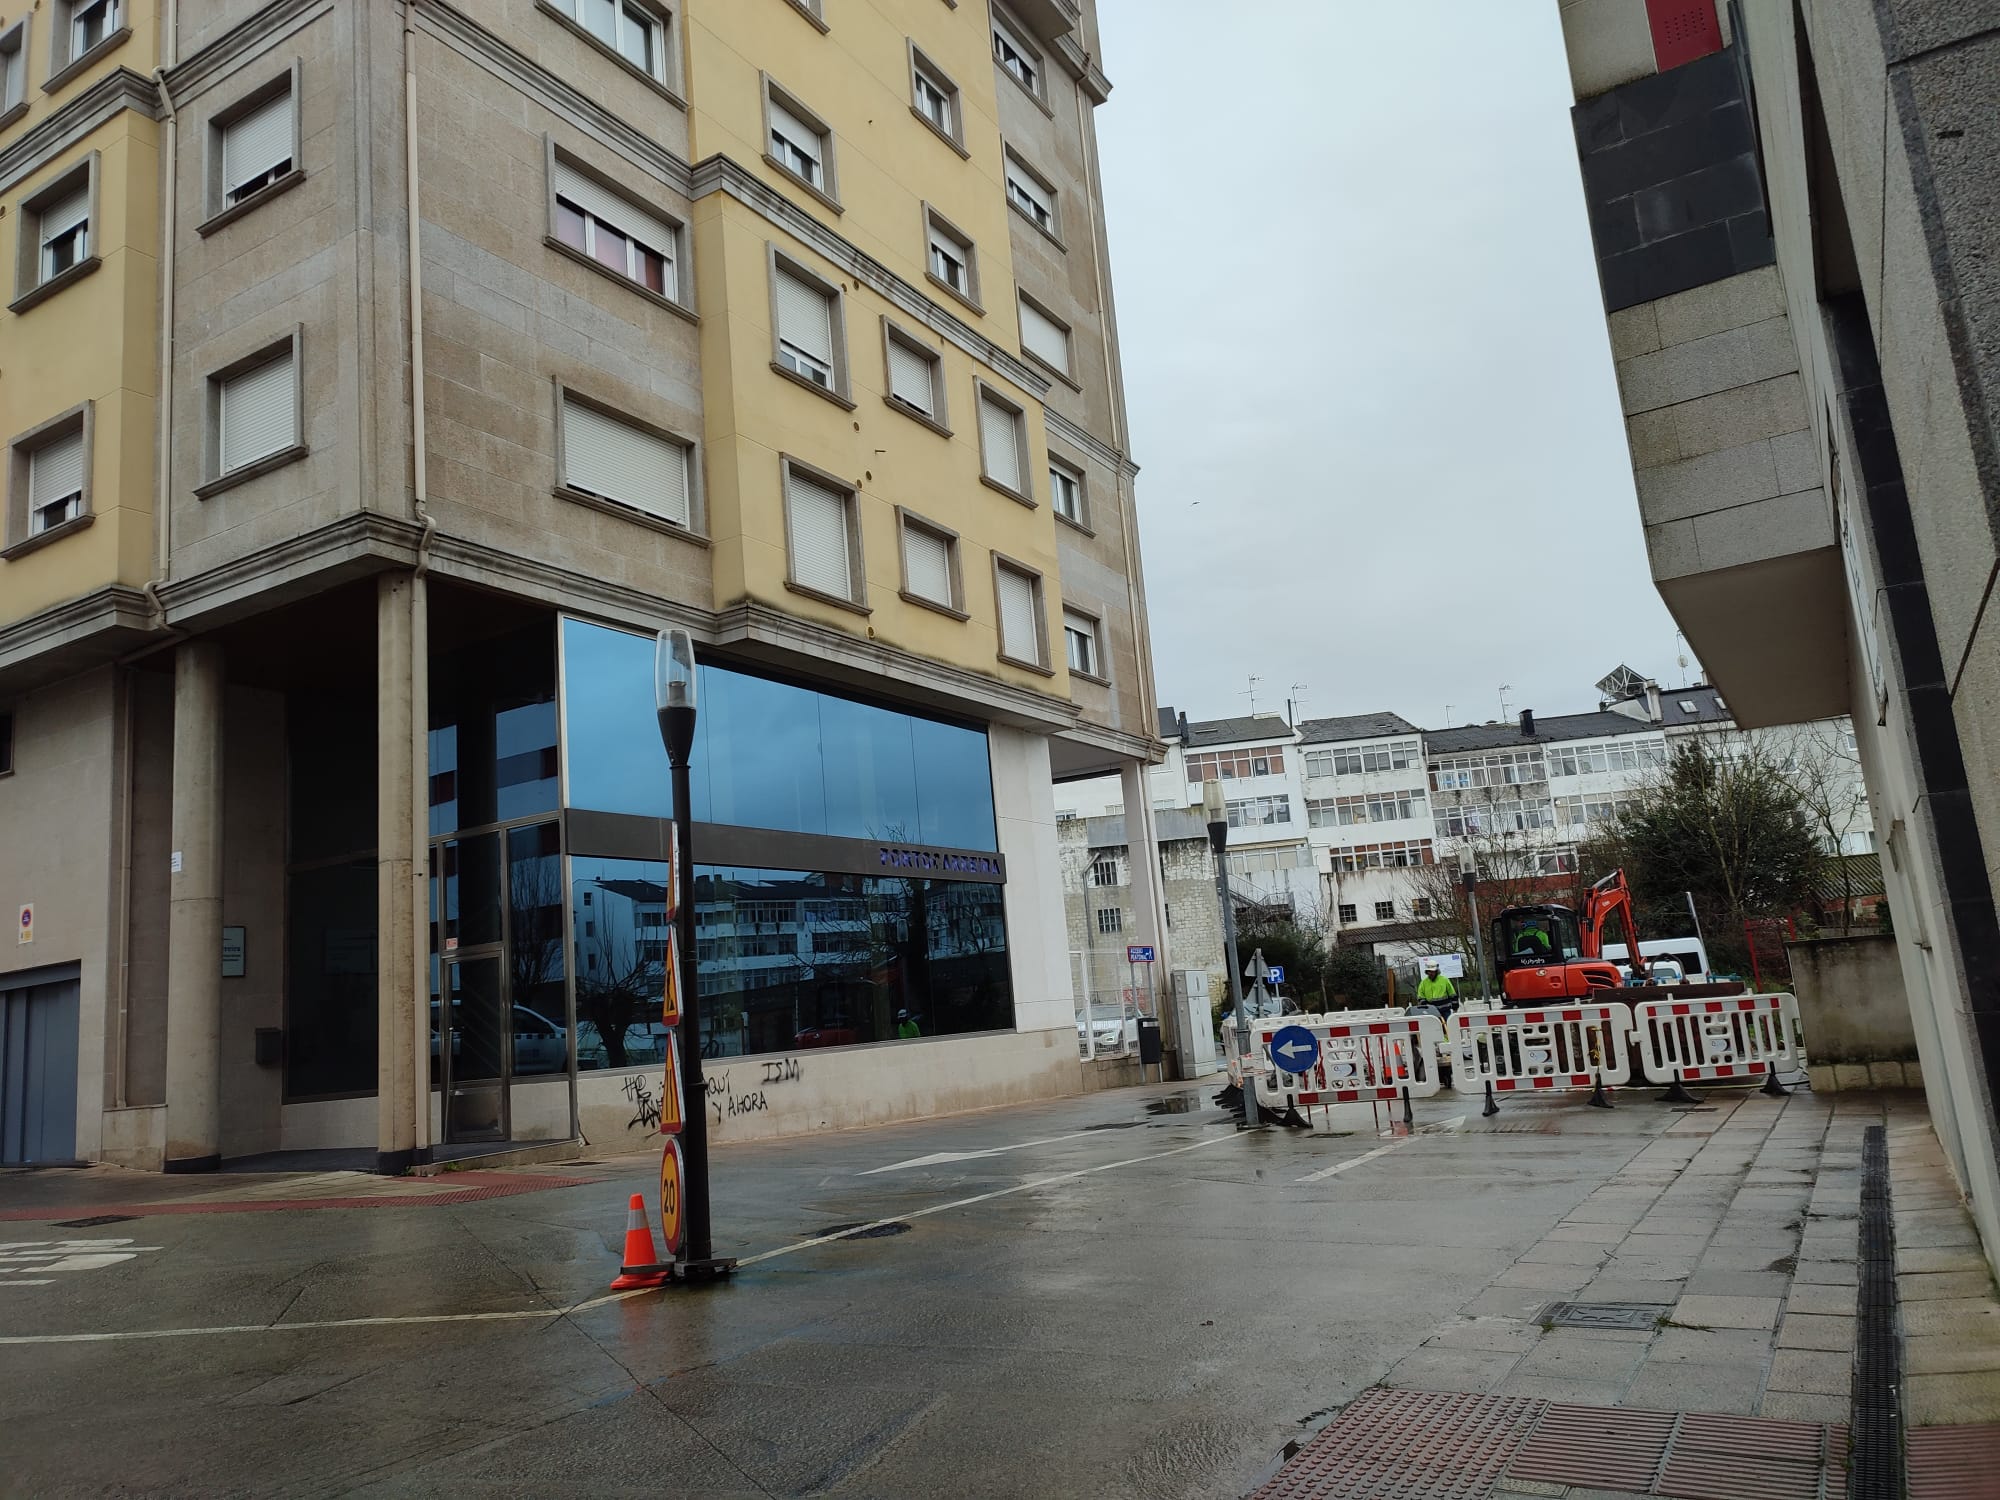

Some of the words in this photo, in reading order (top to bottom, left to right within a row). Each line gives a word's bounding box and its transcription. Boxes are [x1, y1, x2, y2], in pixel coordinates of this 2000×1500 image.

[1270, 968, 1281, 982] P
[727, 1090, 768, 1118] AHORA
[663, 1178, 675, 1216] 20
